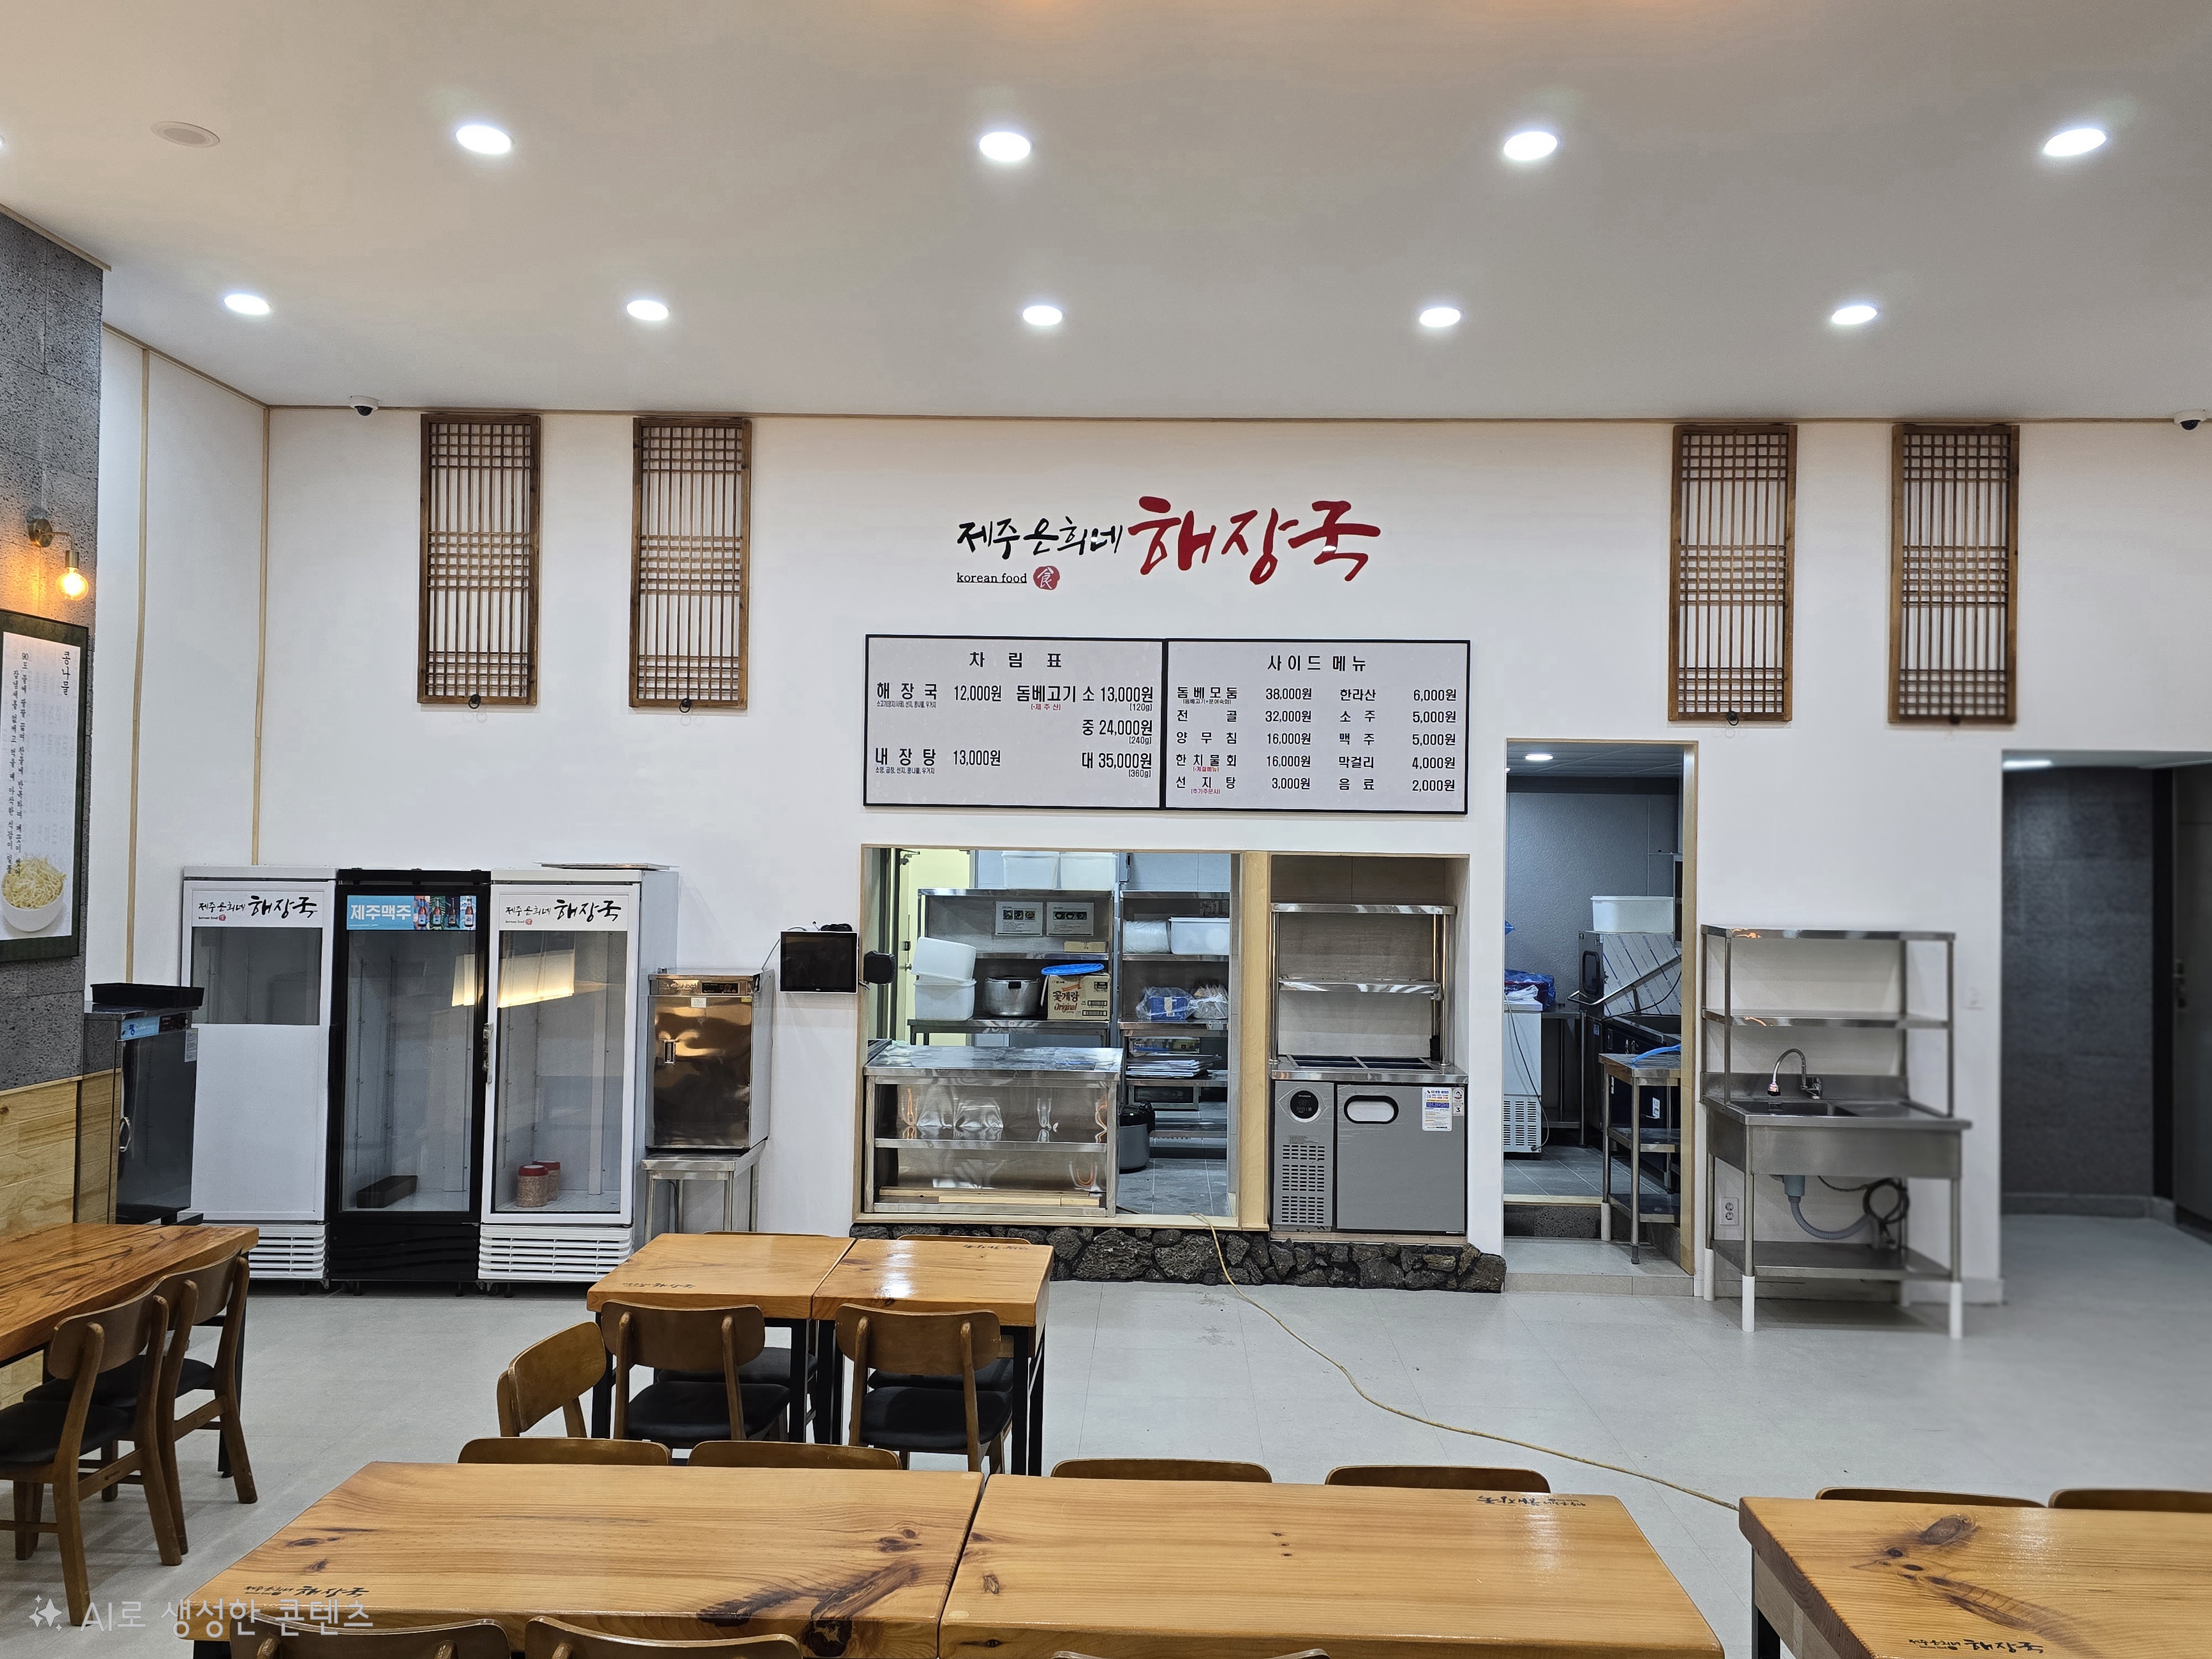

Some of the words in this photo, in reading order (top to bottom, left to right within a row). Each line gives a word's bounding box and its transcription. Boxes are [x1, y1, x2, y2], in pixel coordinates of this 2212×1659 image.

[1128, 495, 1381, 585] 해장국
[957, 572, 997, 583] korean
[1001, 573, 1027, 584] food
[969, 651, 1062, 668] 차림표
[1267, 655, 1321, 671] 사이드
[1332, 655, 1366, 672] 메뉴
[877, 682, 937, 700] 해장국
[954, 685, 1001, 702] 12,000원
[1016, 685, 1076, 702] 돔베고기
[1083, 686, 1094, 701] 소
[1100, 686, 1153, 703] 13,000원
[1177, 687, 1238, 699] 돔베모둠
[1265, 688, 1312, 701] 38,000원
[1340, 689, 1376, 702] 한라산
[1413, 690, 1457, 702] 6,000원
[1129, 703, 1152, 712] (120g)
[1177, 709, 1237, 722] 전골
[1265, 711, 1312, 723] 32,000원
[1339, 712, 1376, 723] 소주
[1412, 712, 1457, 724] 5,000원
[1082, 719, 1094, 735] 중
[1099, 719, 1152, 737] 24,000원
[1176, 732, 1237, 744] 양무침
[1266, 733, 1311, 745] 16,000원
[1339, 734, 1375, 746] 맥주
[1412, 734, 1456, 747] 5,000원
[875, 748, 936, 766] 내장탕
[953, 750, 1001, 766] 13,000원
[1082, 752, 1093, 769] 대
[1098, 753, 1152, 770] 35,000원
[1176, 754, 1237, 766] 한치물회
[1266, 755, 1311, 768] 16,000원
[1338, 756, 1374, 769] 막걸리
[1411, 757, 1456, 770] 4,000원
[1128, 769, 1151, 778] (360g)
[1176, 776, 1236, 789] 선지탕
[1272, 777, 1311, 790] 3,000원
[1338, 779, 1375, 791] 음료
[1412, 779, 1455, 792] 2,000원
[248, 895, 317, 919] 해장국
[350, 905, 411, 920] 제주맥주
[554, 899, 622, 922] 해장국
[1053, 991, 1079, 1002] 꽃게랑
[1054, 1003, 1078, 1013] Original
